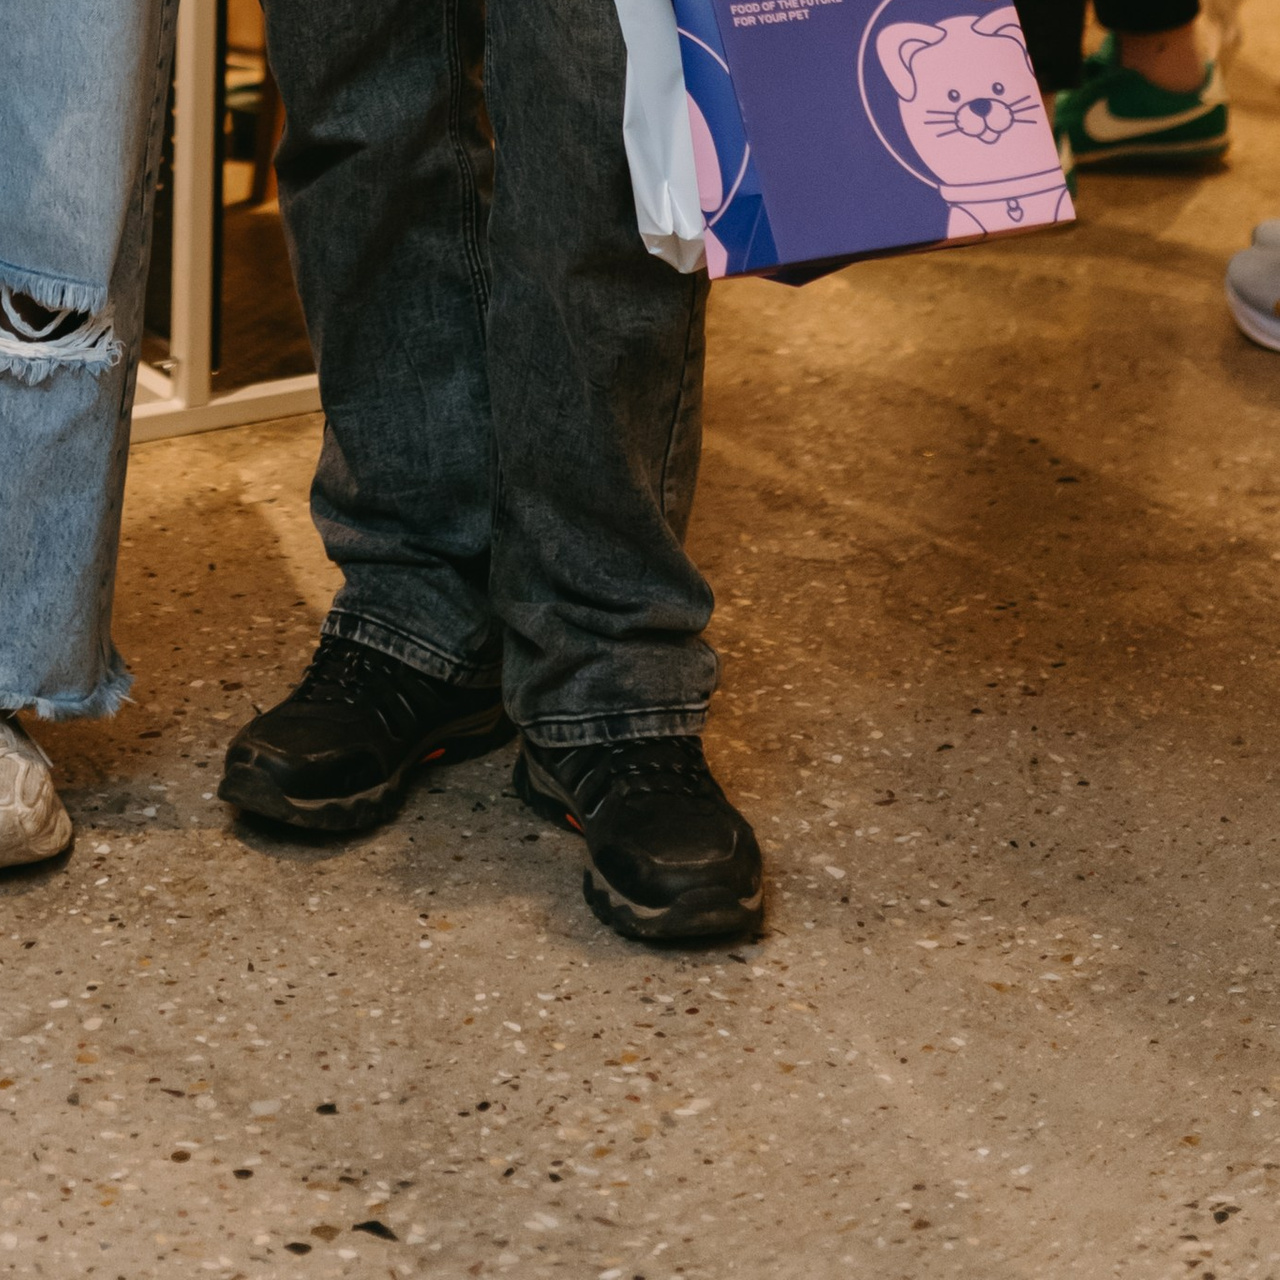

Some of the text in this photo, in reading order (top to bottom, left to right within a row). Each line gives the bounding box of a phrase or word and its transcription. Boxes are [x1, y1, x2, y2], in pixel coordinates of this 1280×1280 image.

[730, 3, 760, 15] FOOD
[762, 1, 776, 12] OF
[733, 9, 810, 27] FOR YOUR PET
